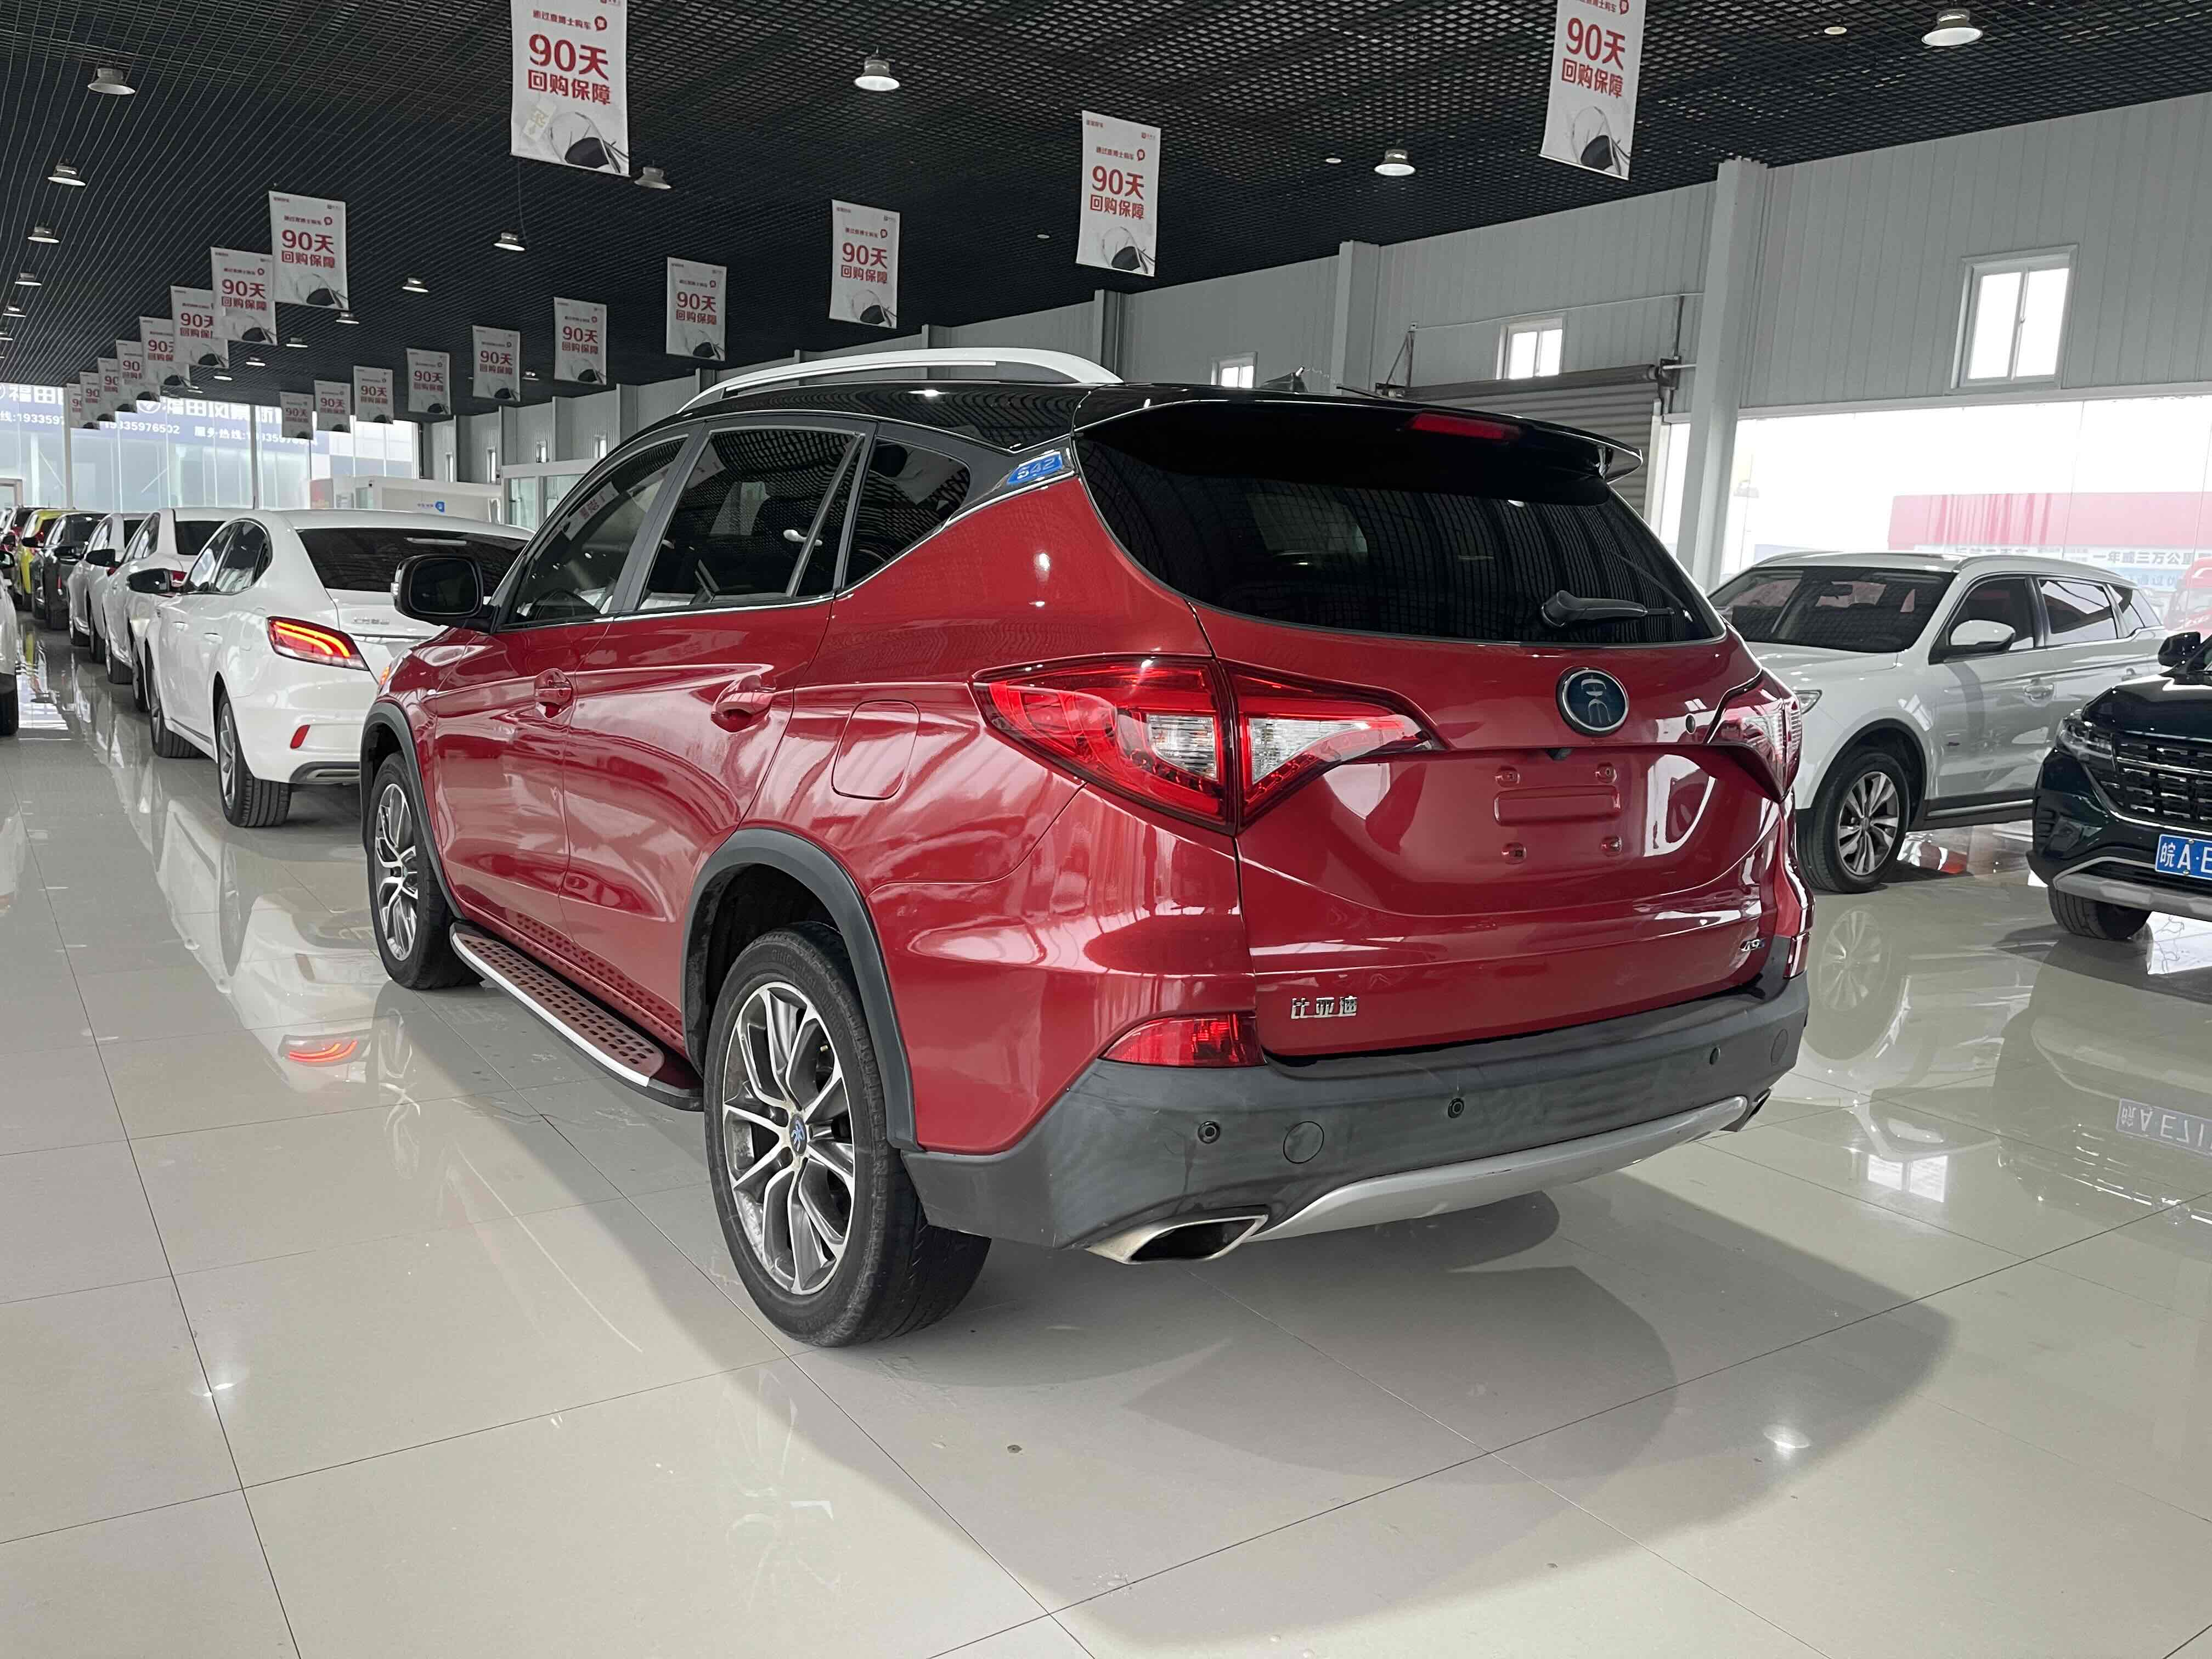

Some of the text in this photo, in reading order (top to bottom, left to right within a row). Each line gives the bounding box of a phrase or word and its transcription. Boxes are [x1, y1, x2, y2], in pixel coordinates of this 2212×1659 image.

[1566, 18, 1625, 70] 90天
[528, 34, 609, 81] 90天
[527, 69, 611, 105] 回购保障
[1561, 58, 1623, 98] 回购保障
[1092, 166, 1144, 200] 90天
[1090, 194, 1144, 219] 回购保障
[281, 229, 334, 254] 90天
[281, 250, 335, 268] 回购保障
[842, 242, 887, 269] 90天
[841, 264, 888, 284] 回购保障
[222, 279, 266, 298] 90天
[677, 291, 716, 312] 90天
[562, 326, 598, 343] 90天
[479, 351, 513, 366] 90天
[414, 370, 444, 383] 90天
[360, 386, 387, 397] 90天
[1291, 996, 1357, 1019] 比亚迪
